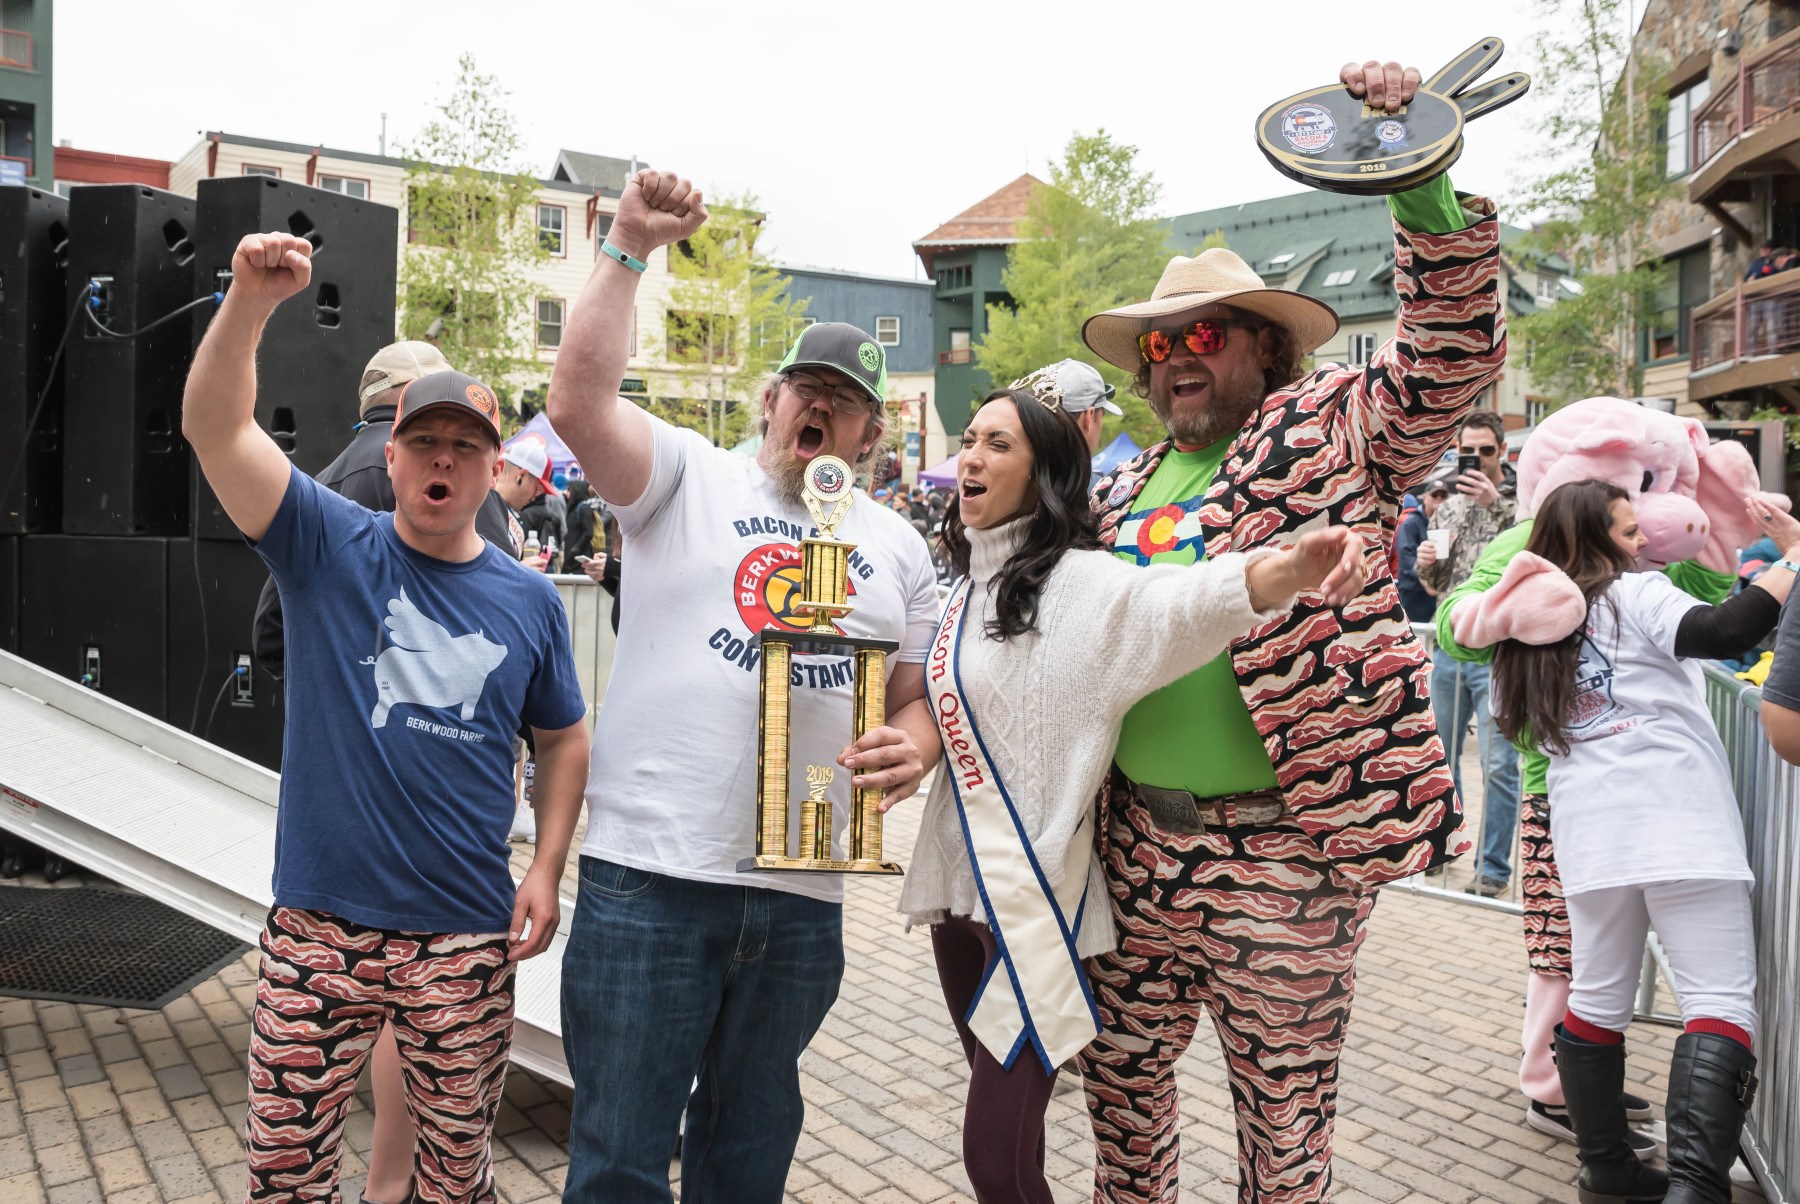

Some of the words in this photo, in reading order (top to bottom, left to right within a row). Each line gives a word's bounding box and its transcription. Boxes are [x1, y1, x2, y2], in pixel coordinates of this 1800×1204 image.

[1360, 163, 1387, 173] 2019
[733, 516, 803, 541] BACON
[932, 596, 965, 683] Bacon
[708, 627, 855, 690] CONSTANT
[406, 716, 459, 739] BERKWOOD
[459, 729, 485, 743] FARMS
[938, 691, 984, 791] Queen
[805, 764, 834, 783] 2019
